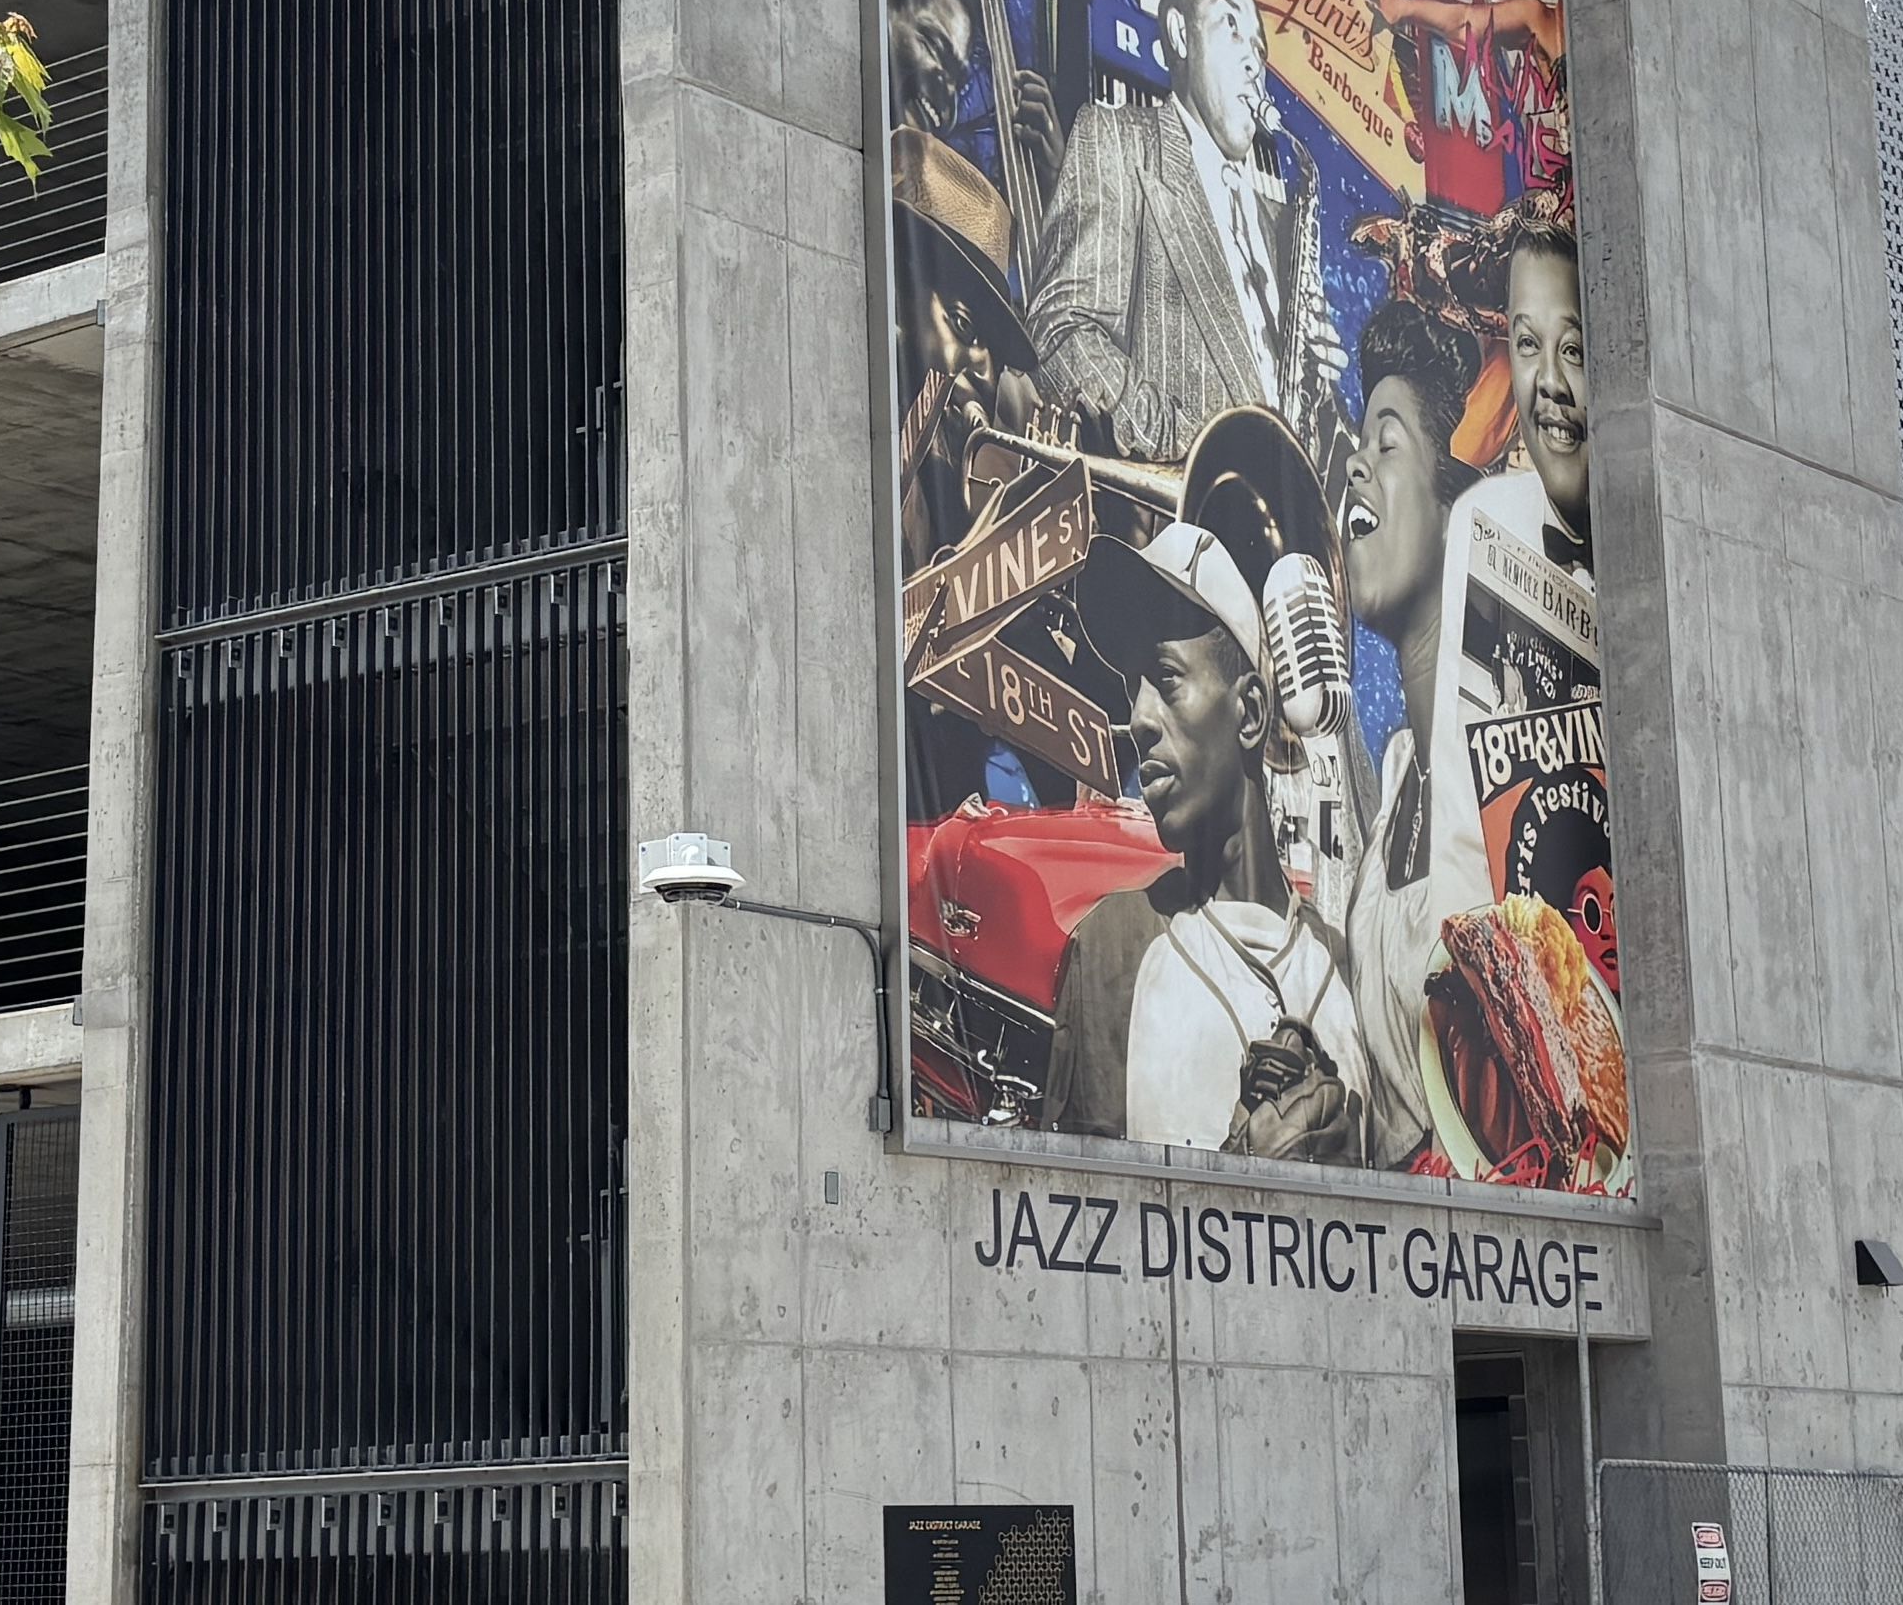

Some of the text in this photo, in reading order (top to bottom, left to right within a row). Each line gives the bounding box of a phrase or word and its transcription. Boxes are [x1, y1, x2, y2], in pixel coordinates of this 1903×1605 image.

[1306, 37, 1394, 147] Barbeque
[952, 491, 1085, 624] VINE ST
[983, 651, 1054, 736] 18TH
[1068, 712, 1110, 781] ST
[975, 1189, 1602, 1312] JAZZ DISTRICT GARAGE
